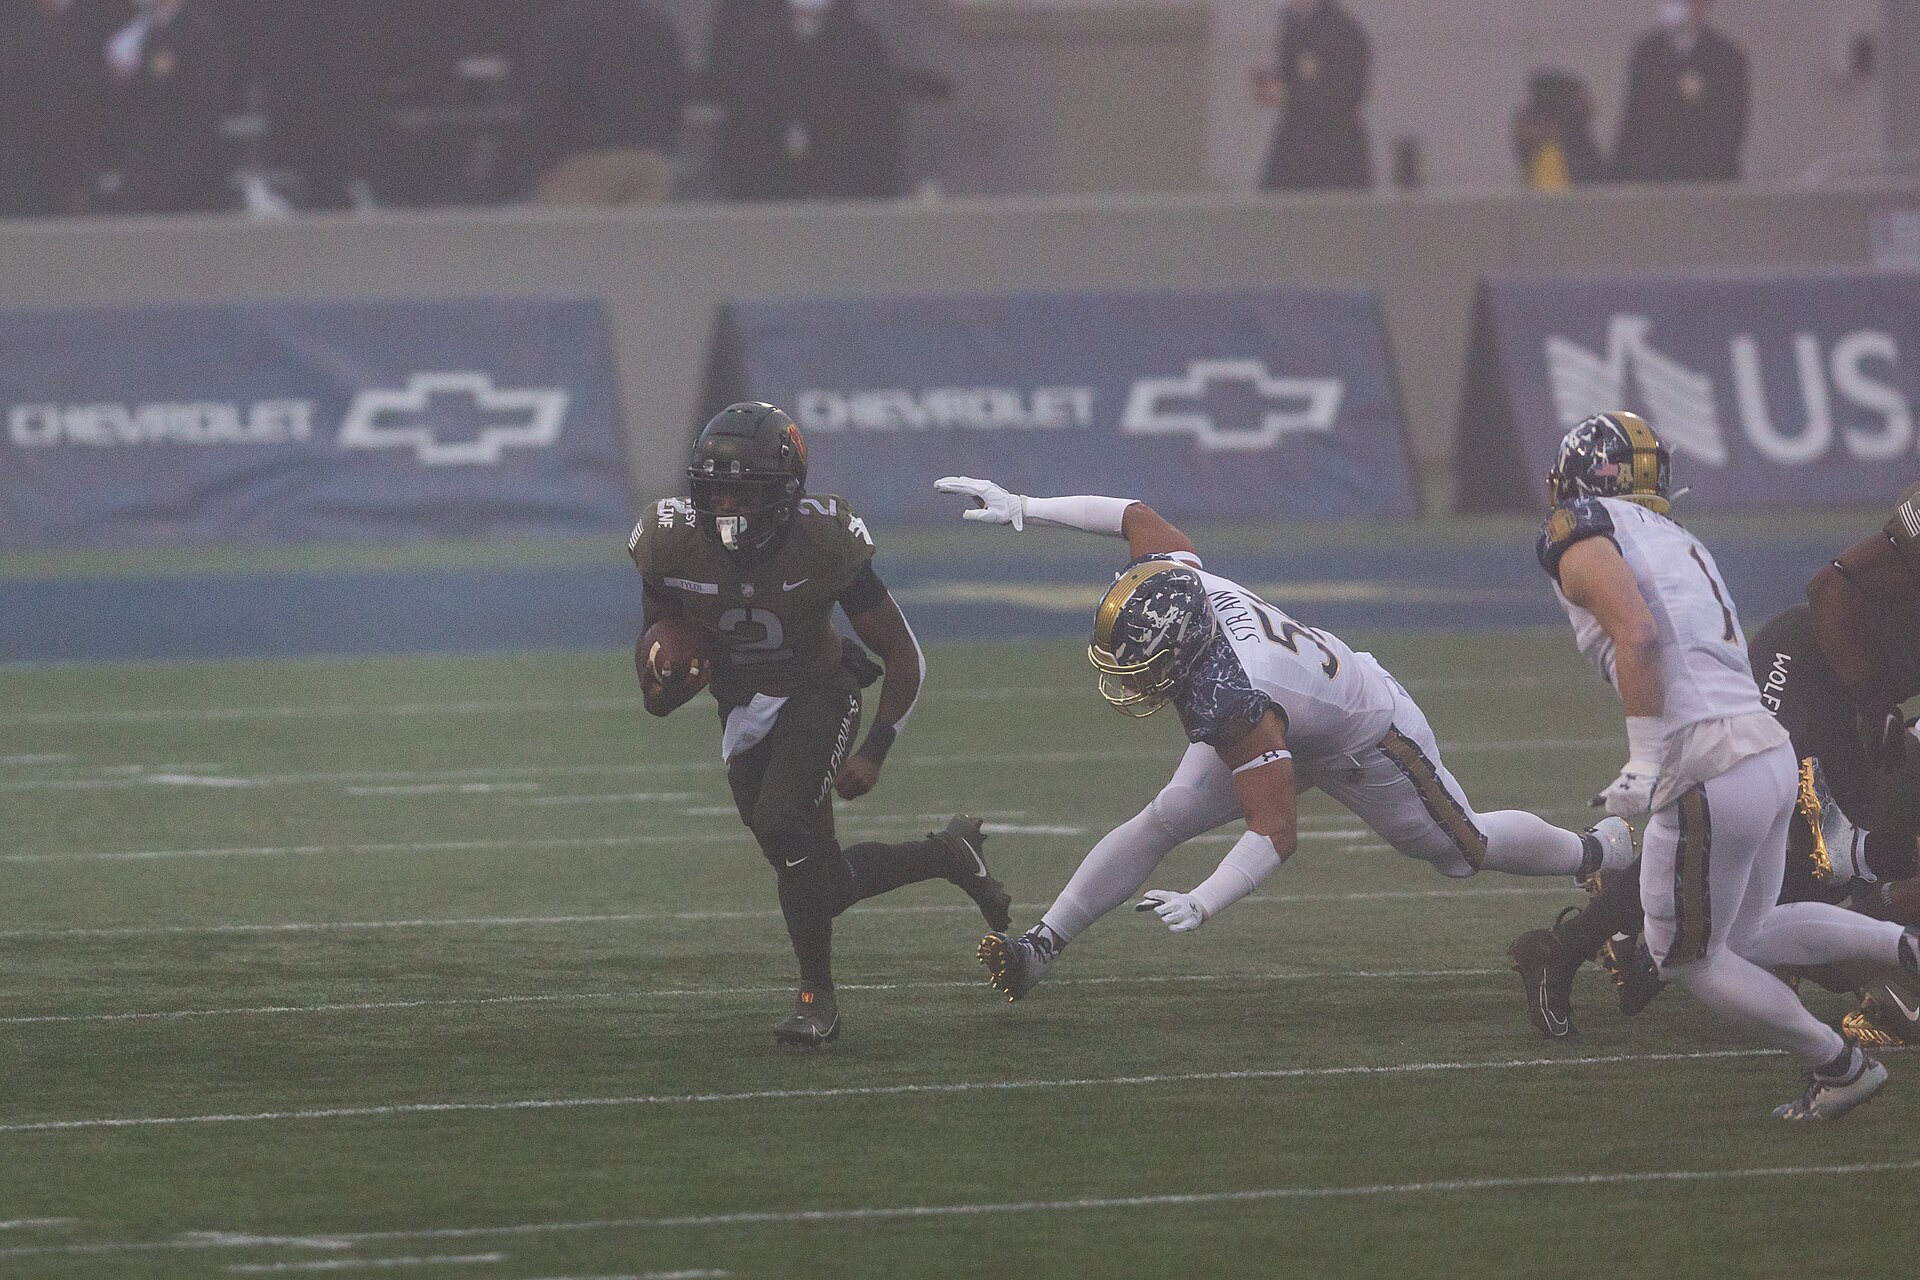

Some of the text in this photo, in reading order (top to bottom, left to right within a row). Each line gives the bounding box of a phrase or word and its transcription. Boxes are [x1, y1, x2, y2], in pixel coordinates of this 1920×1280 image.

[9, 399, 315, 446] CHEVROLET
[796, 385, 1094, 431] CHEVROLET
[1729, 331, 1919, 465] US
[1688, 544, 1738, 646] 1
[718, 607, 793, 665] 2
[1246, 600, 1341, 682] 5
[1763, 653, 1792, 716] WOLF
